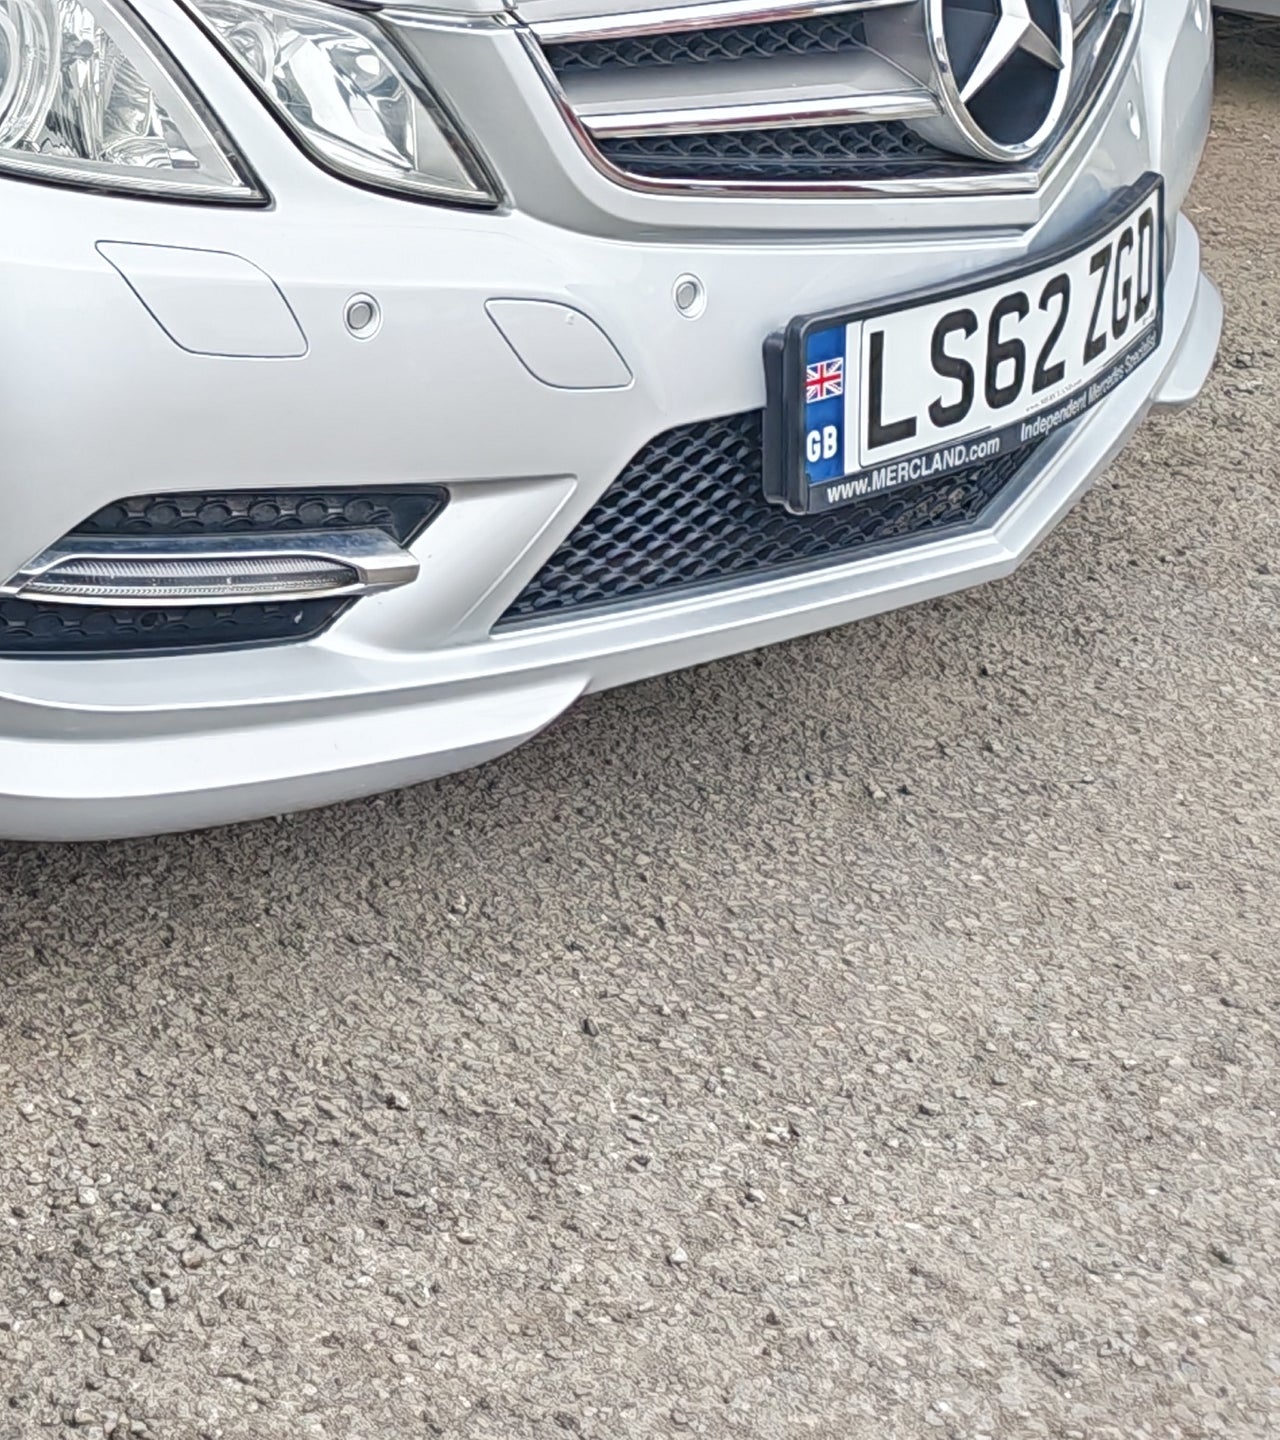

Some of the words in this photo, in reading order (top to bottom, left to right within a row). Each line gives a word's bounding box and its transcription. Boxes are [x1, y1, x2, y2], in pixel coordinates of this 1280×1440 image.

[867, 272, 1071, 451] LS62
[1082, 206, 1155, 368] ZGD
[806, 424, 838, 463] GB
[827, 437, 1001, 504] www.MERCLAND.com
[1020, 390, 1087, 442] Independent
